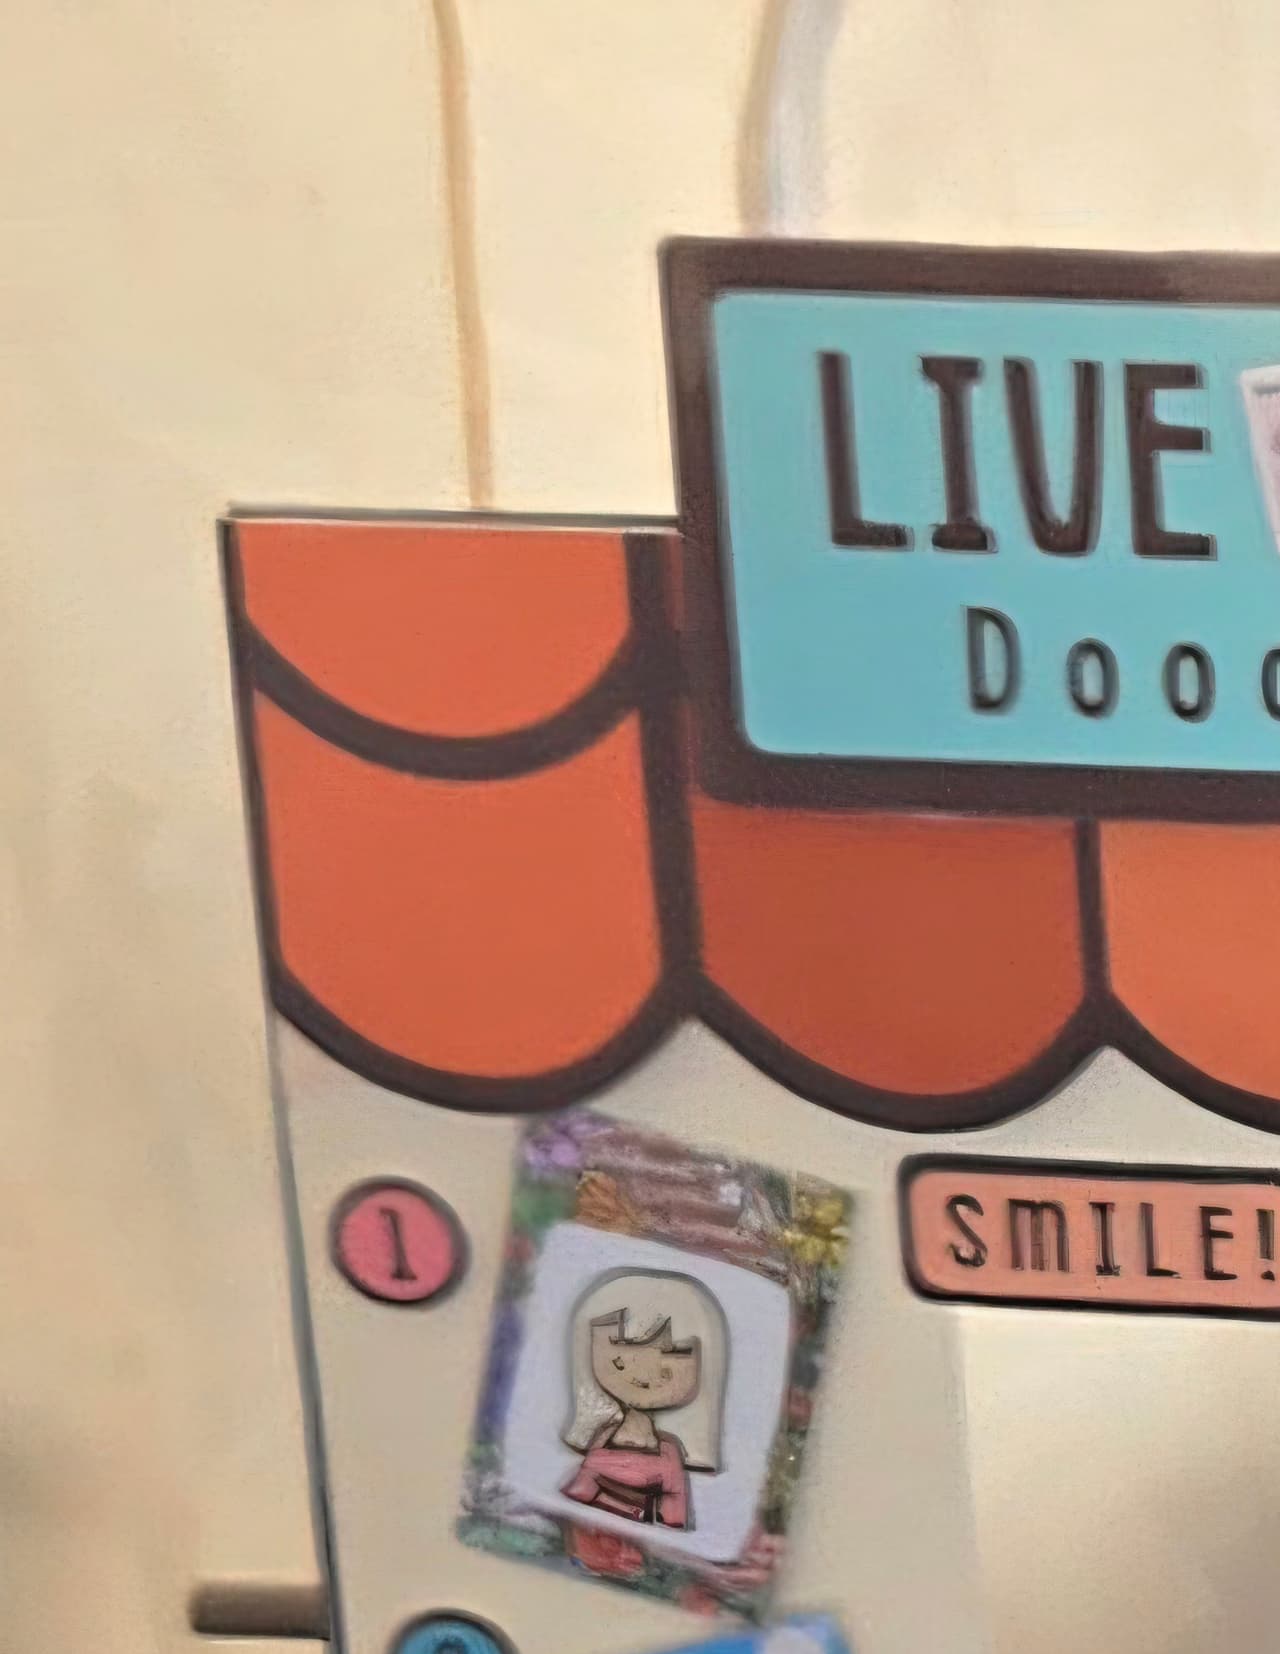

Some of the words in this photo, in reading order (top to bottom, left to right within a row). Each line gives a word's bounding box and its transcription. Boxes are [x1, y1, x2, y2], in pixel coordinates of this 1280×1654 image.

[815, 349, 1218, 560] LIVE
[379, 1206, 418, 1281] 1
[945, 1193, 1280, 1283] SMILE!
